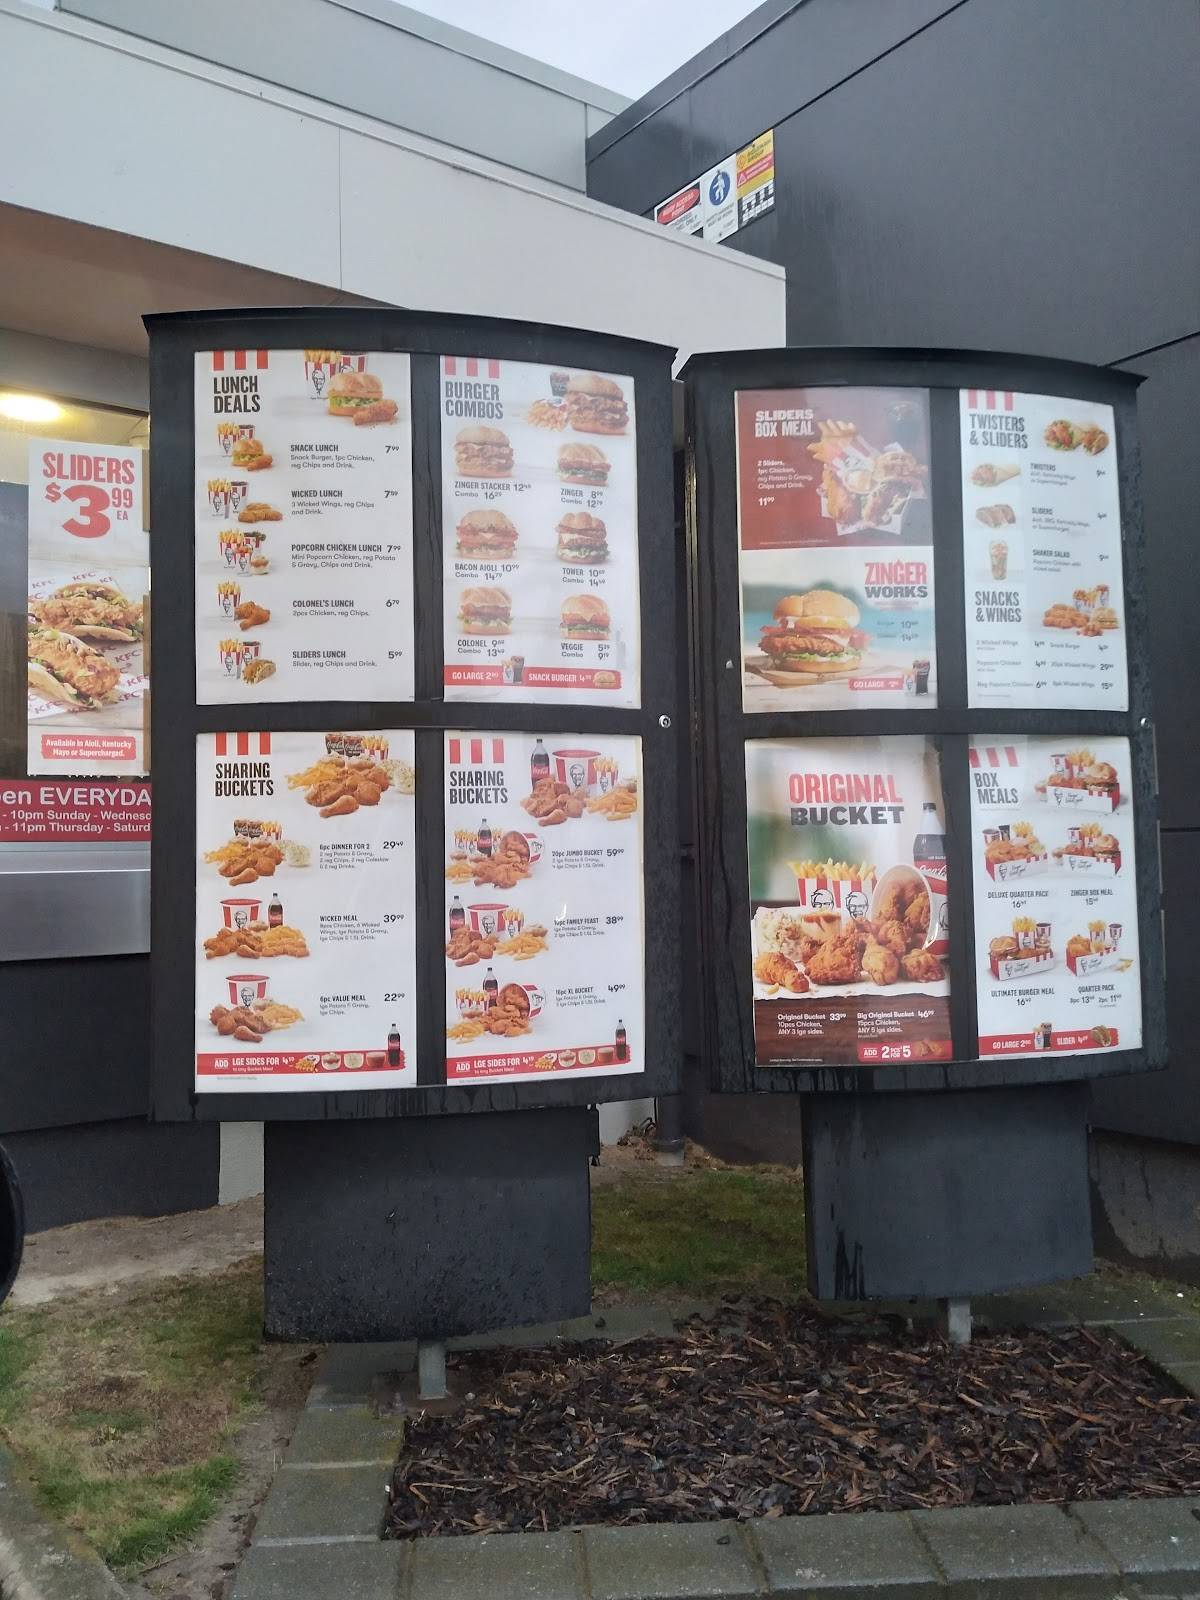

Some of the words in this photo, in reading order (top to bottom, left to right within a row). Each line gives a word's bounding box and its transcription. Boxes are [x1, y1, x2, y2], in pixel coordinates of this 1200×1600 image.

[213, 376, 258, 394] LUNCH
[445, 381, 500, 400] BURGER
[213, 394, 260, 414] DEALS
[445, 400, 504, 420] COMBOS
[756, 409, 814, 421] SLIDERS
[755, 422, 778, 438] BOX
[782, 421, 814, 436] MEAL
[969, 414, 1024, 432] TWISTERS
[970, 431, 980, 446] &
[982, 432, 1028, 449] SLIDERS
[42, 452, 135, 485] SLIDERS
[454, 481, 479, 489] ZINGER
[481, 482, 510, 490] STACKER
[561, 488, 583, 497] ZINGER
[116, 510, 128, 521] EA
[326, 544, 357, 552] CHICKEN
[562, 568, 583, 576] TOWER
[864, 562, 928, 585] ZINGER
[865, 586, 928, 598] WORKS
[975, 591, 1019, 607] SNACKS
[976, 608, 984, 622] &
[986, 608, 1022, 622] WINGS
[551, 674, 577, 682] BURGER
[102, 740, 132, 749] Kentucky
[80, 749, 125, 758] Supercharged.
[215, 762, 270, 779] SHARING
[449, 770, 504, 787] SHARING
[974, 773, 999, 787] BOX
[215, 780, 274, 797] BUCKETS
[789, 774, 903, 804] ORIGINAL
[449, 788, 507, 804] BUCKETS
[977, 788, 1018, 804] MEALS
[11, 810, 43, 820] 10pm
[47, 810, 90, 821] Sunday
[790, 806, 904, 825] BUCKET
[13, 822, 45, 833] 11pm
[49, 822, 103, 833] Thursday
[114, 823, 150, 832] Saturd
[1057, 1037, 1075, 1045] SLIDER
[882, 1046, 890, 1058] 2
[215, 1060, 229, 1068] ADD
[456, 1063, 470, 1071] ADD
[474, 1060, 486, 1068] LGE
[487, 1059, 506, 1067] SIDES
